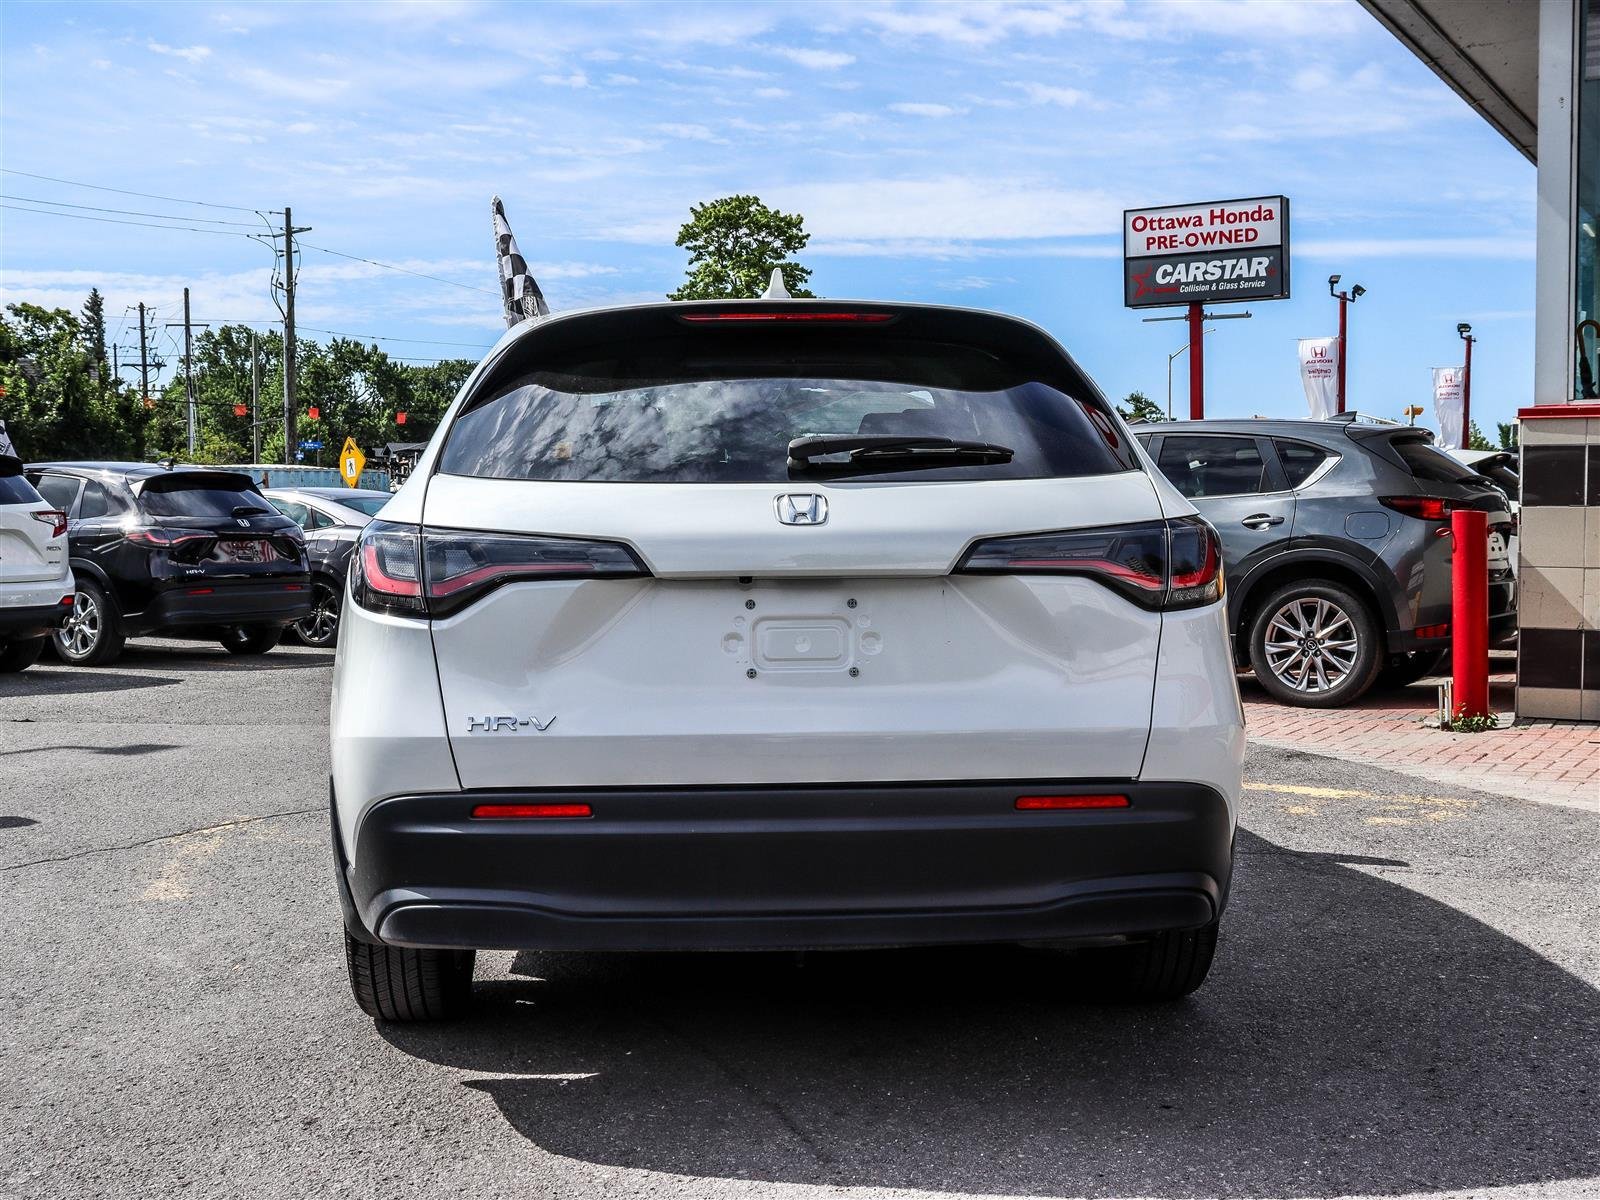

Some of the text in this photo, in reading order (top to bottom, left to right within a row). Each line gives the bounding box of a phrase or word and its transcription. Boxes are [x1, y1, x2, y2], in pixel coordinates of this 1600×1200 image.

[1132, 205, 1275, 232] Ottawa Honda
[1146, 227, 1258, 250] PRE-OWNED
[1155, 256, 1269, 284] CARSTAR
[1179, 280, 1266, 293] Collision & Glass Service
[467, 716, 557, 731] HR-V
